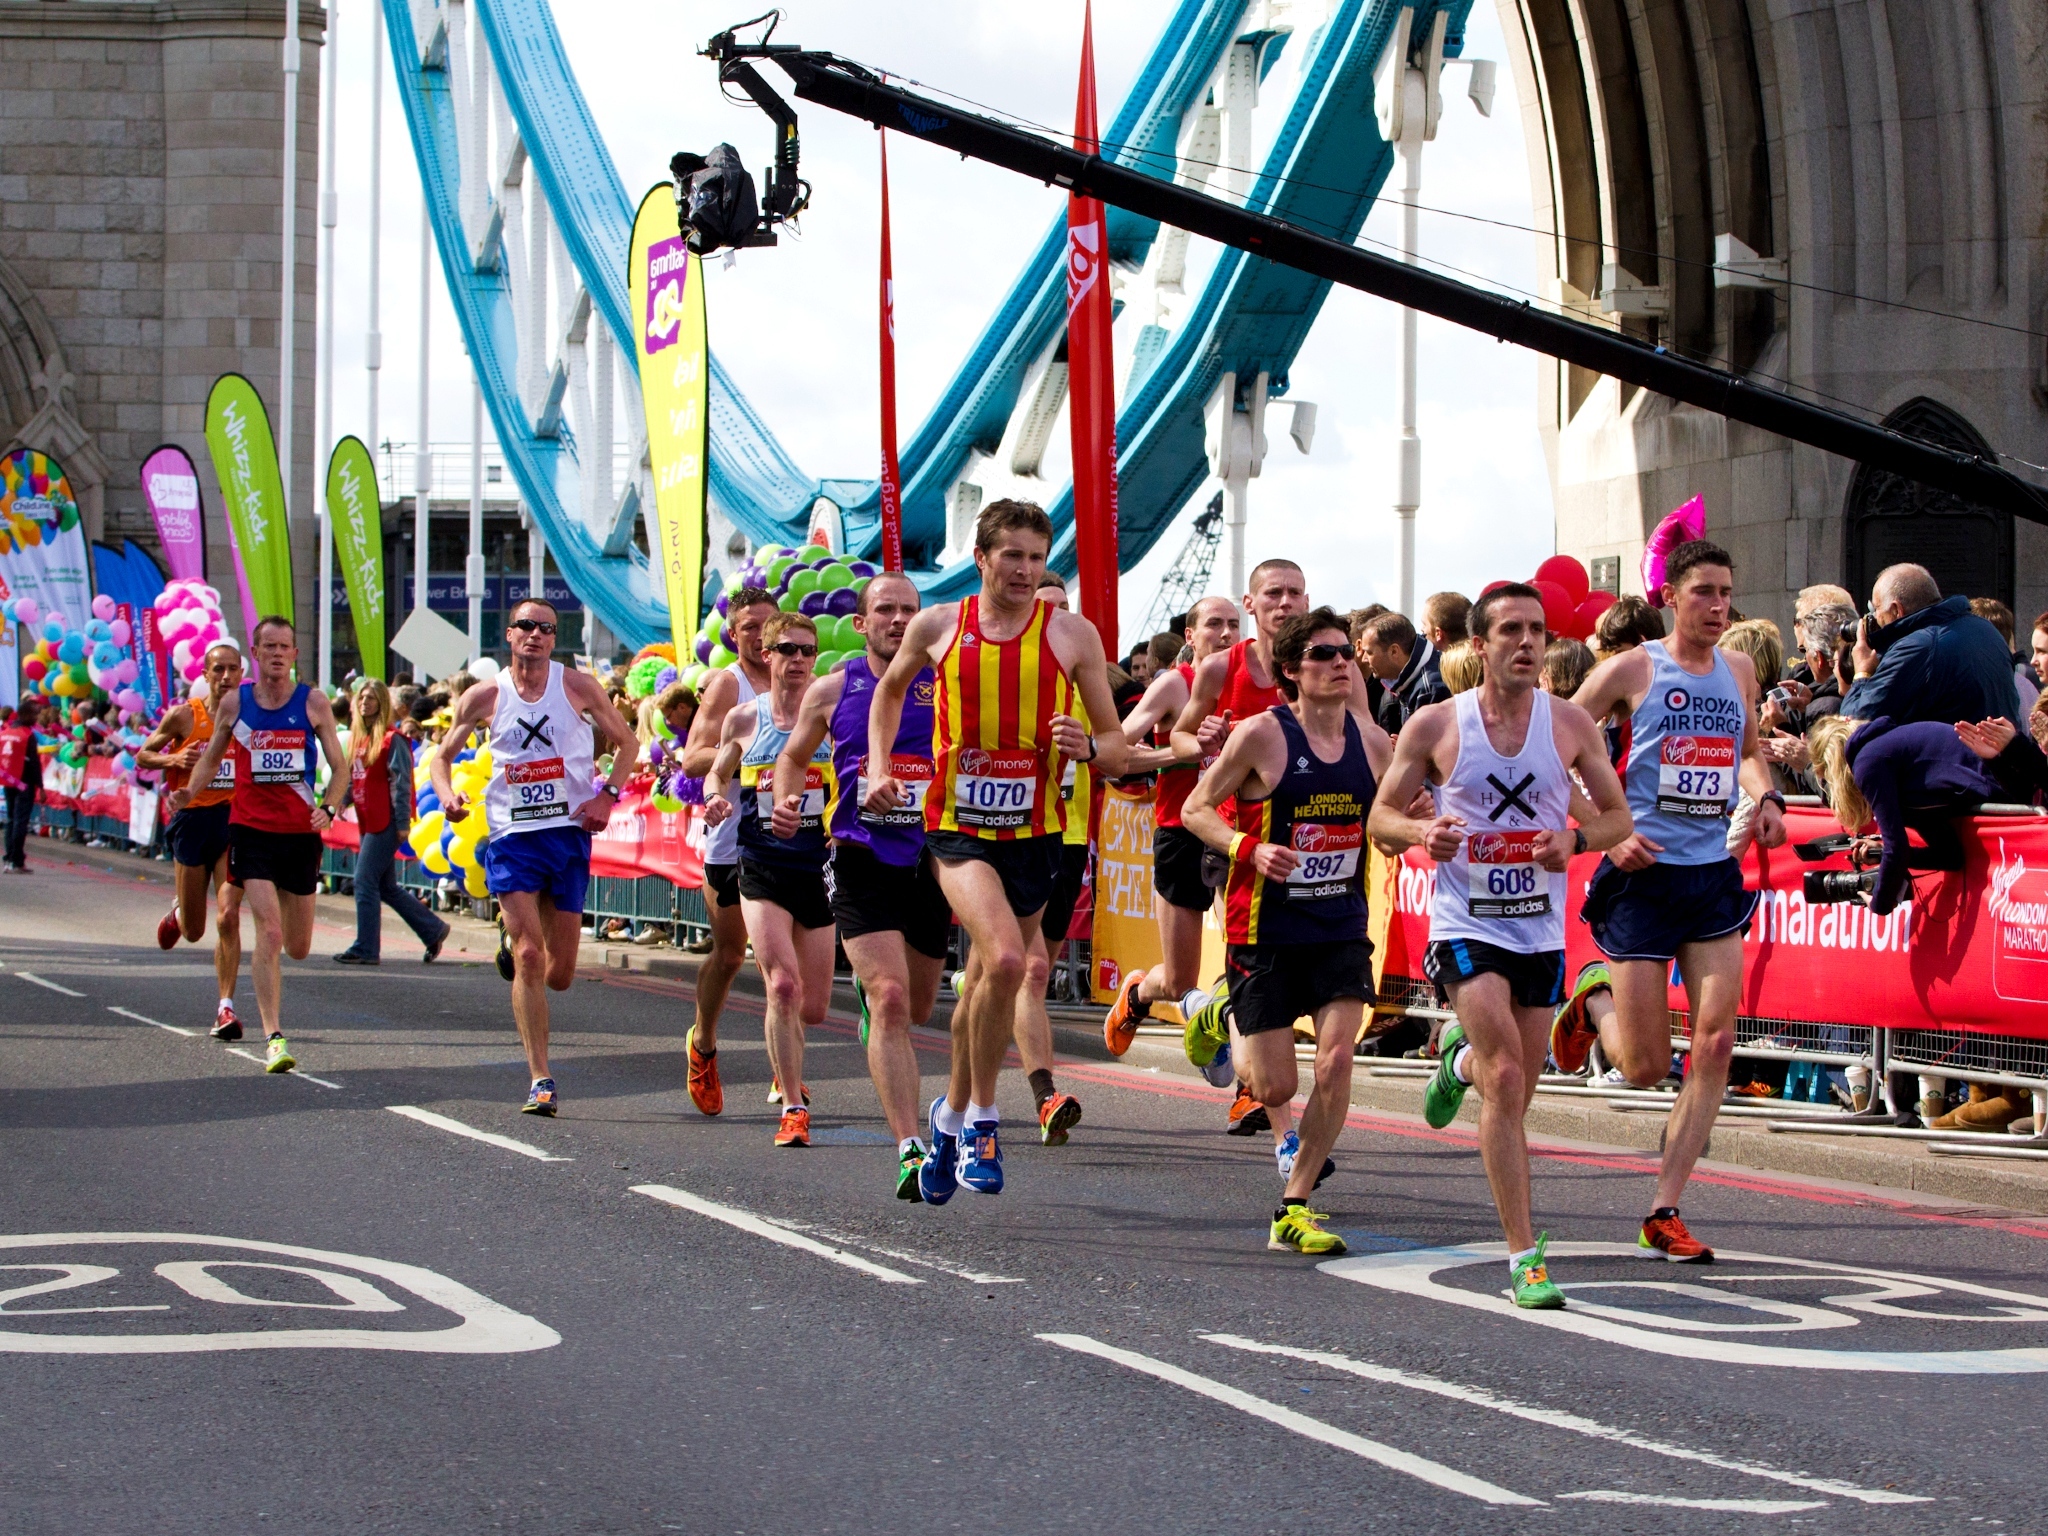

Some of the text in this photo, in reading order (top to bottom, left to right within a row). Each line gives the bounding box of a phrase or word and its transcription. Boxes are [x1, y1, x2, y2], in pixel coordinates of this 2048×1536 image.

[898, 102, 949, 133] TRIANGLE
[1692, 696, 1741, 718] ROYAL
[528, 711, 536, 721] T
[513, 725, 555, 740] H H
[1657, 715, 1742, 735] AIR FORCE
[252, 730, 304, 749] Virgin money
[745, 753, 775, 763] GARDEN
[1666, 737, 1732, 763] Virgin money
[262, 752, 294, 769] 892
[962, 749, 1034, 775] Virgin money
[271, 773, 300, 782] adidas
[532, 763, 562, 777] money
[1505, 766, 1516, 780] T
[1676, 770, 1720, 796] 873
[521, 783, 555, 804] 929
[966, 780, 1027, 807] 1070
[1309, 793, 1353, 805] LONDON
[1481, 791, 1540, 805] H H
[533, 805, 563, 817] adidas
[1294, 804, 1363, 818] HEATHSIDE
[1687, 803, 1722, 815] adidas
[984, 815, 1025, 826] adidas
[1508, 815, 1520, 828] &
[1296, 825, 1361, 851] Virgin money
[1474, 834, 1505, 862] Virgin
[1303, 854, 1345, 879] 897
[1487, 866, 1536, 896] 608
[1988, 837, 2026, 921] Virgin
[1315, 884, 1347, 896] adidas
[1503, 900, 1545, 915] adidas
[2004, 901, 2047, 925] LONDON
